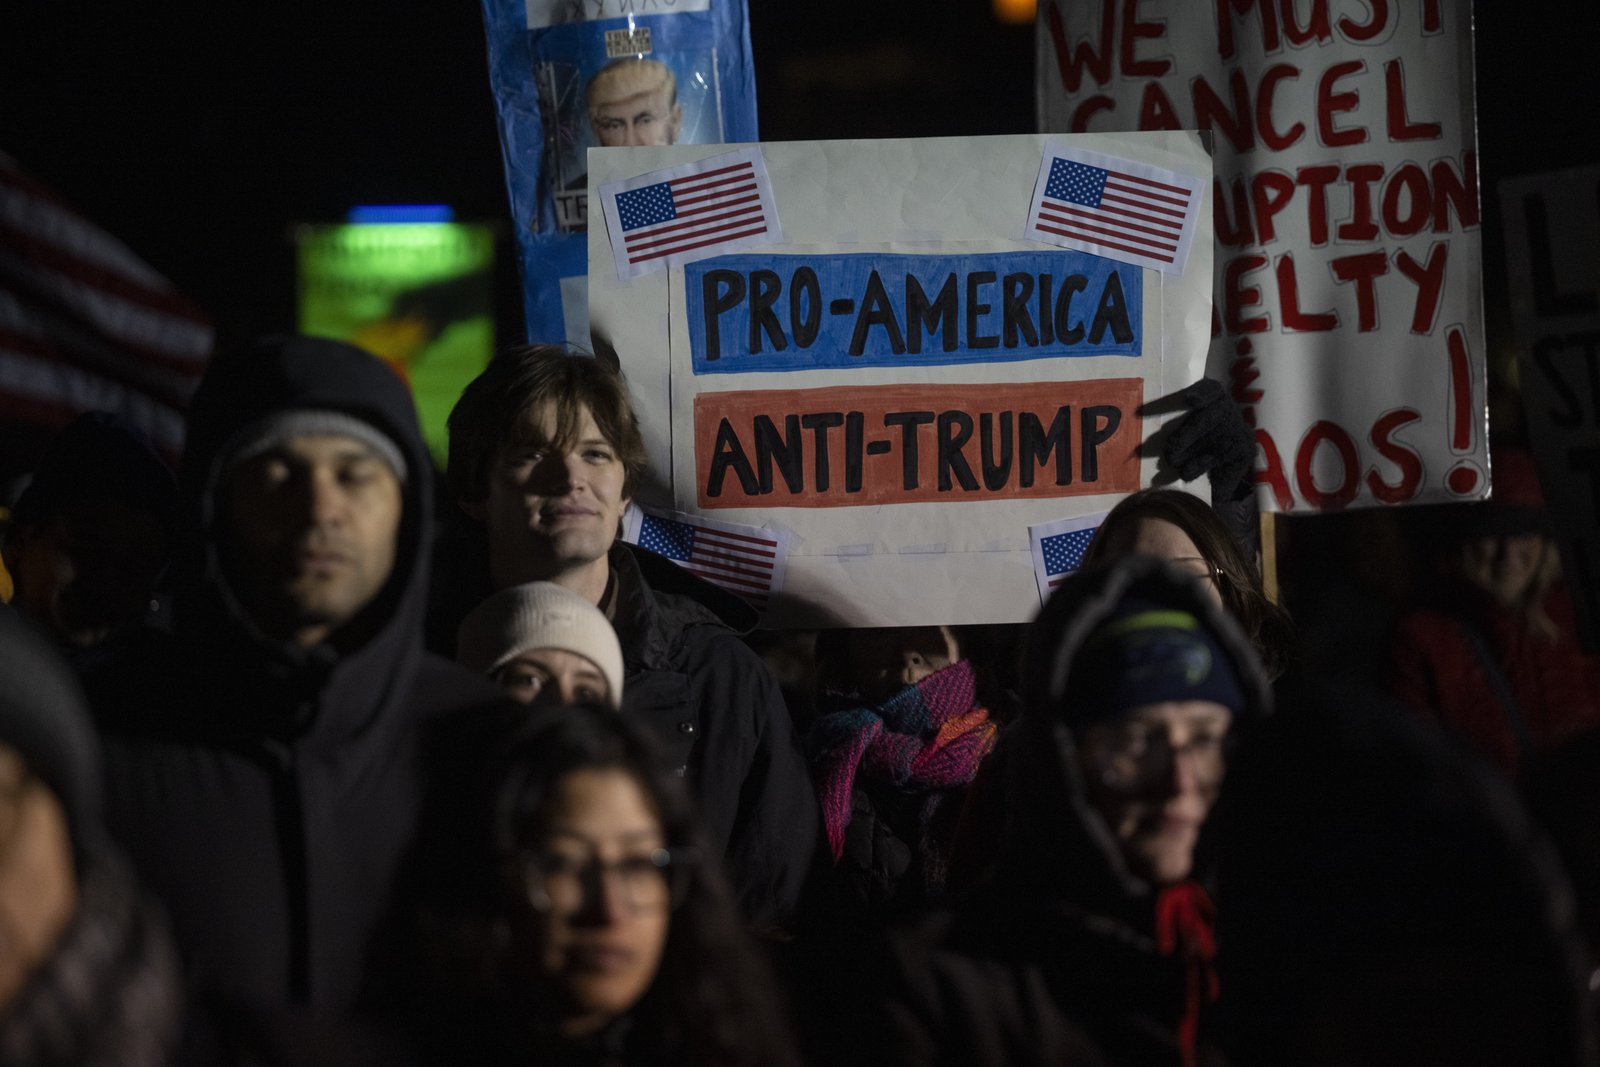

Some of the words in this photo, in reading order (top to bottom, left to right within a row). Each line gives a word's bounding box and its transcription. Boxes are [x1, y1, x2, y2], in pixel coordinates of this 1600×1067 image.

[1047, 0, 1171, 93] WE
[1213, 151, 1479, 246] UPTION
[702, 266, 1135, 361] PRO-AMERICA
[1212, 243, 1445, 336] ELTY
[706, 405, 1122, 498] ANTI-TRUMP
